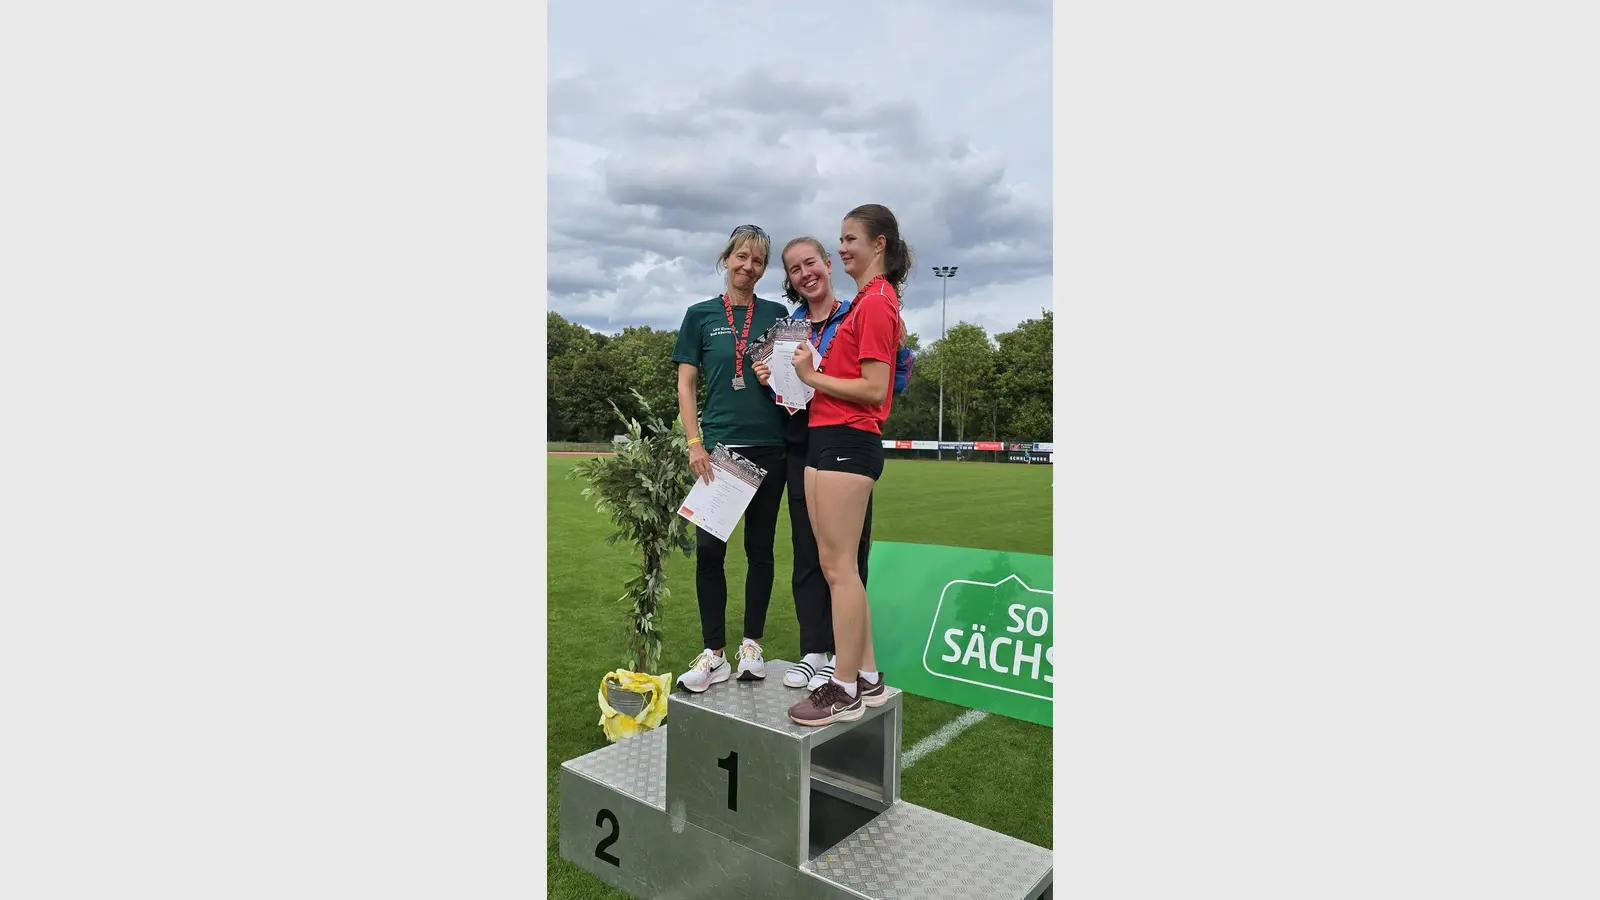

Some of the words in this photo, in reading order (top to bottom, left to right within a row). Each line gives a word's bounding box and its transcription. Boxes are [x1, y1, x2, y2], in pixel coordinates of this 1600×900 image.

[1006, 603, 1049, 637] SO
[717, 750, 738, 812] 1
[594, 808, 620, 867] 2
